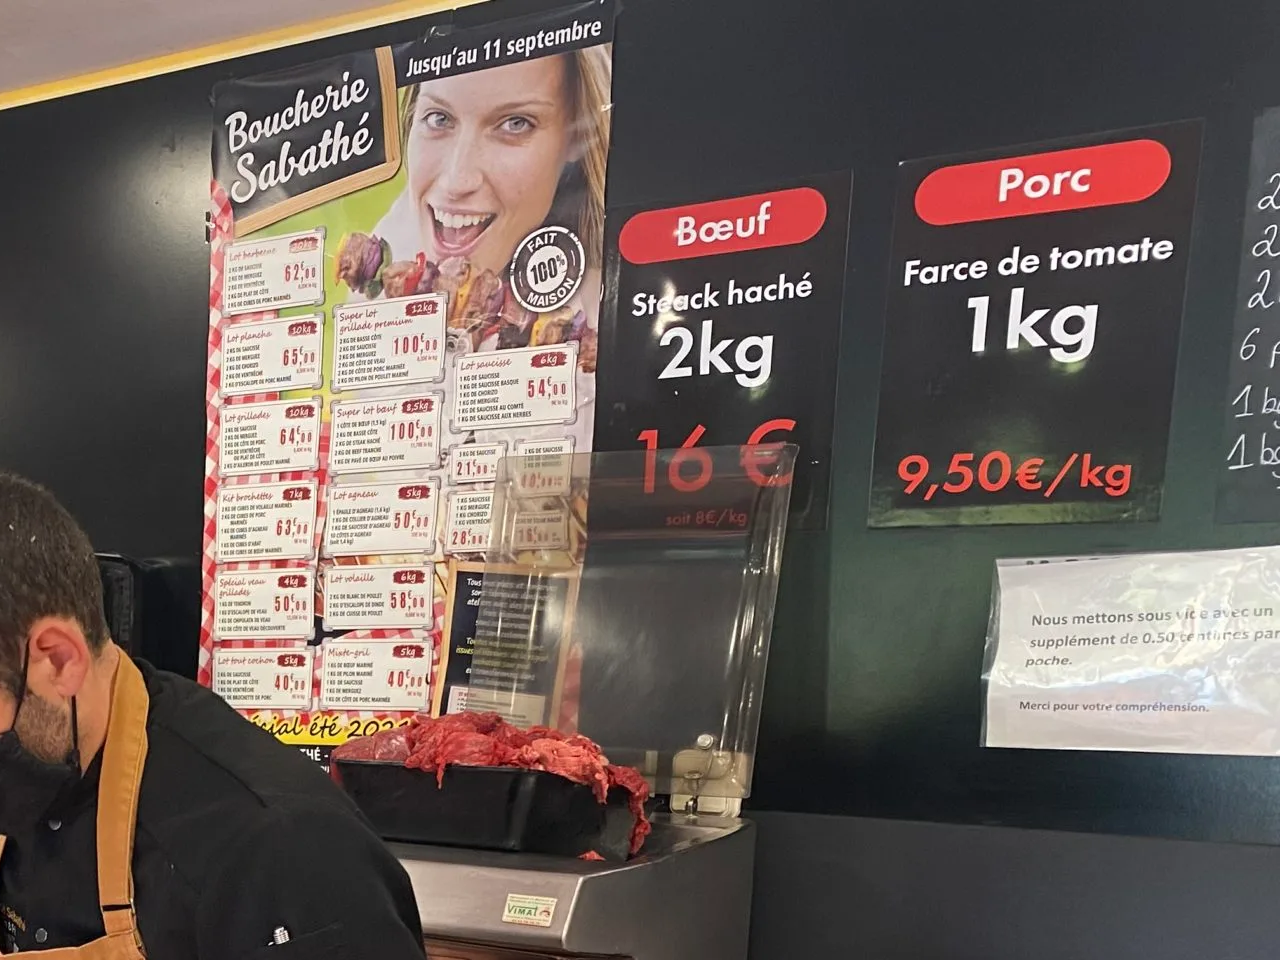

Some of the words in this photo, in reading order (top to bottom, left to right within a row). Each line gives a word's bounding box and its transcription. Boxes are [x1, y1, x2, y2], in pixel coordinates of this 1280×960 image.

[406, 47, 478, 78] Jusqu'au
[483, 40, 502, 60] 11
[506, 19, 602, 56] septembre
[224, 71, 370, 154] Boucherie
[230, 112, 374, 204] Sabathé
[998, 167, 1092, 202] Porc
[677, 201, 772, 247] Bœuf
[525, 231, 557, 253] FAIT
[903, 259, 988, 286] Farce
[997, 246, 1040, 277] de
[1050, 237, 1174, 273] tomate
[529, 254, 566, 286] 100%
[526, 277, 577, 308] MAISON
[631, 282, 720, 317] Steack
[727, 271, 813, 306] haché
[1248, 269, 1274, 309] 2
[412, 304, 432, 313] 12kg
[340, 313, 363, 324] Super
[366, 309, 378, 318] lot
[292, 325, 311, 335] 10kg
[340, 323, 372, 335] grillade
[375, 317, 413, 331] premium
[967, 287, 1099, 364] 1kg
[227, 333, 238, 343] Lot
[240, 329, 272, 343] plancha
[1239, 327, 1260, 361] 6
[541, 354, 557, 365] 6kg
[658, 319, 774, 387] 2kg
[461, 360, 475, 371] Lot
[476, 357, 512, 370] saucisse
[1232, 385, 1254, 419] 1
[224, 414, 236, 423] Lot
[237, 410, 271, 424] grillades
[289, 407, 309, 417] 10kg
[337, 409, 360, 418] Super
[363, 406, 375, 415] lot
[637, 423, 714, 493] 16
[739, 418, 797, 488] €
[1227, 434, 1254, 470] 1
[896, 450, 1132, 501] 9,50€/kg
[223, 494, 234, 502] Kit
[236, 492, 273, 500] brochettes
[289, 489, 303, 499] 7kg
[334, 492, 347, 500] Lot
[348, 491, 378, 501] agneau
[406, 488, 422, 498] 5kg
[666, 512, 690, 526] soit
[695, 507, 748, 527] 8€/kg
[220, 577, 246, 588] Spécial
[284, 577, 298, 587] 4kg
[330, 574, 343, 583] Lot
[345, 572, 375, 583] volaille
[401, 572, 416, 583] 6kg
[219, 588, 250, 599] grillades
[1031, 614, 1068, 626] Nous
[1071, 611, 1134, 625] mettons
[1137, 610, 1171, 622] sous
[1253, 607, 1273, 617] un
[1030, 633, 1116, 649] supplément
[1120, 632, 1138, 645] de
[1142, 631, 1175, 644] 0.50
[1254, 629, 1280, 641] par
[328, 648, 369, 658] Mixte-gril
[400, 645, 416, 657] 5kg
[218, 657, 230, 665] Lot
[232, 656, 246, 665] tout
[247, 656, 276, 664] cochon
[284, 655, 299, 667] 5kg
[1025, 655, 1073, 668] poche.
[1019, 701, 1051, 711] Merci
[1053, 701, 1078, 712] pour
[1082, 702, 1112, 711] votre
[1115, 701, 1210, 713] compréhension.
[310, 718, 342, 738] été
